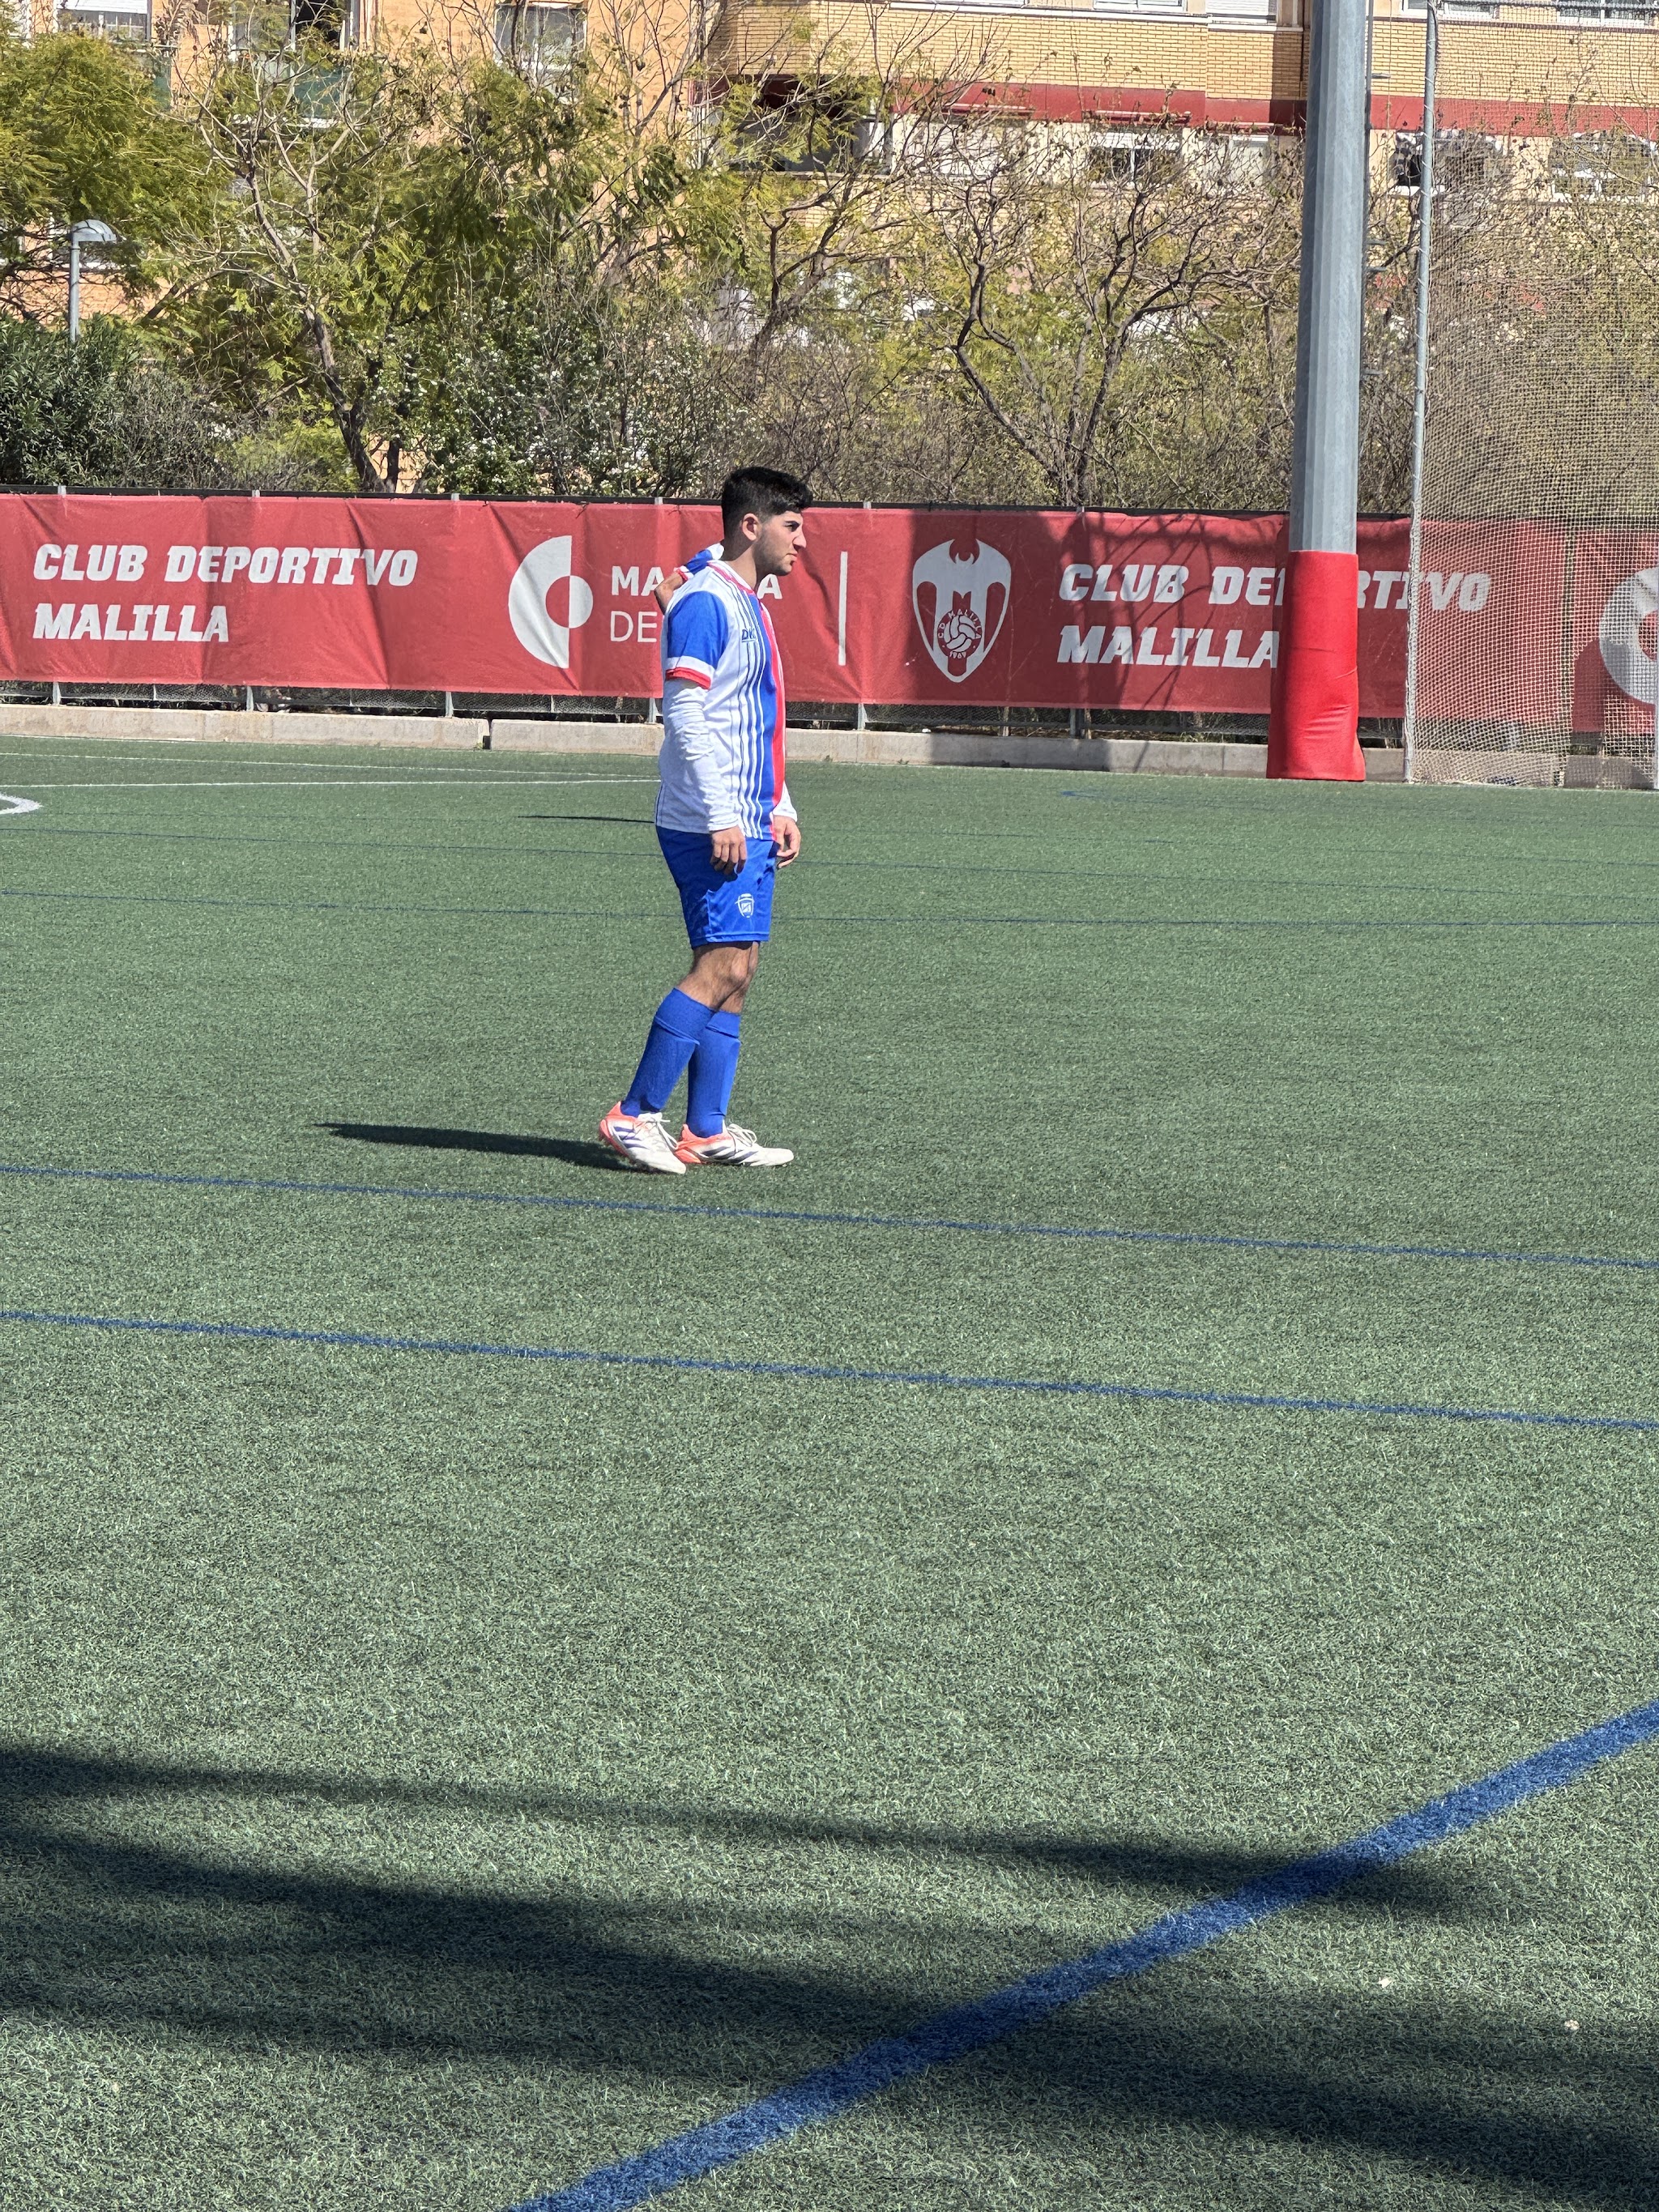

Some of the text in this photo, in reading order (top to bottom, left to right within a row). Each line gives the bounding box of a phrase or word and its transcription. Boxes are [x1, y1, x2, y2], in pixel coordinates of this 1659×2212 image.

[33, 543, 418, 586] CLUB DEPORTIVO
[1059, 564, 1189, 603] CLUB
[32, 603, 229, 642] MALILLA
[1056, 625, 1280, 668] MALILLA
